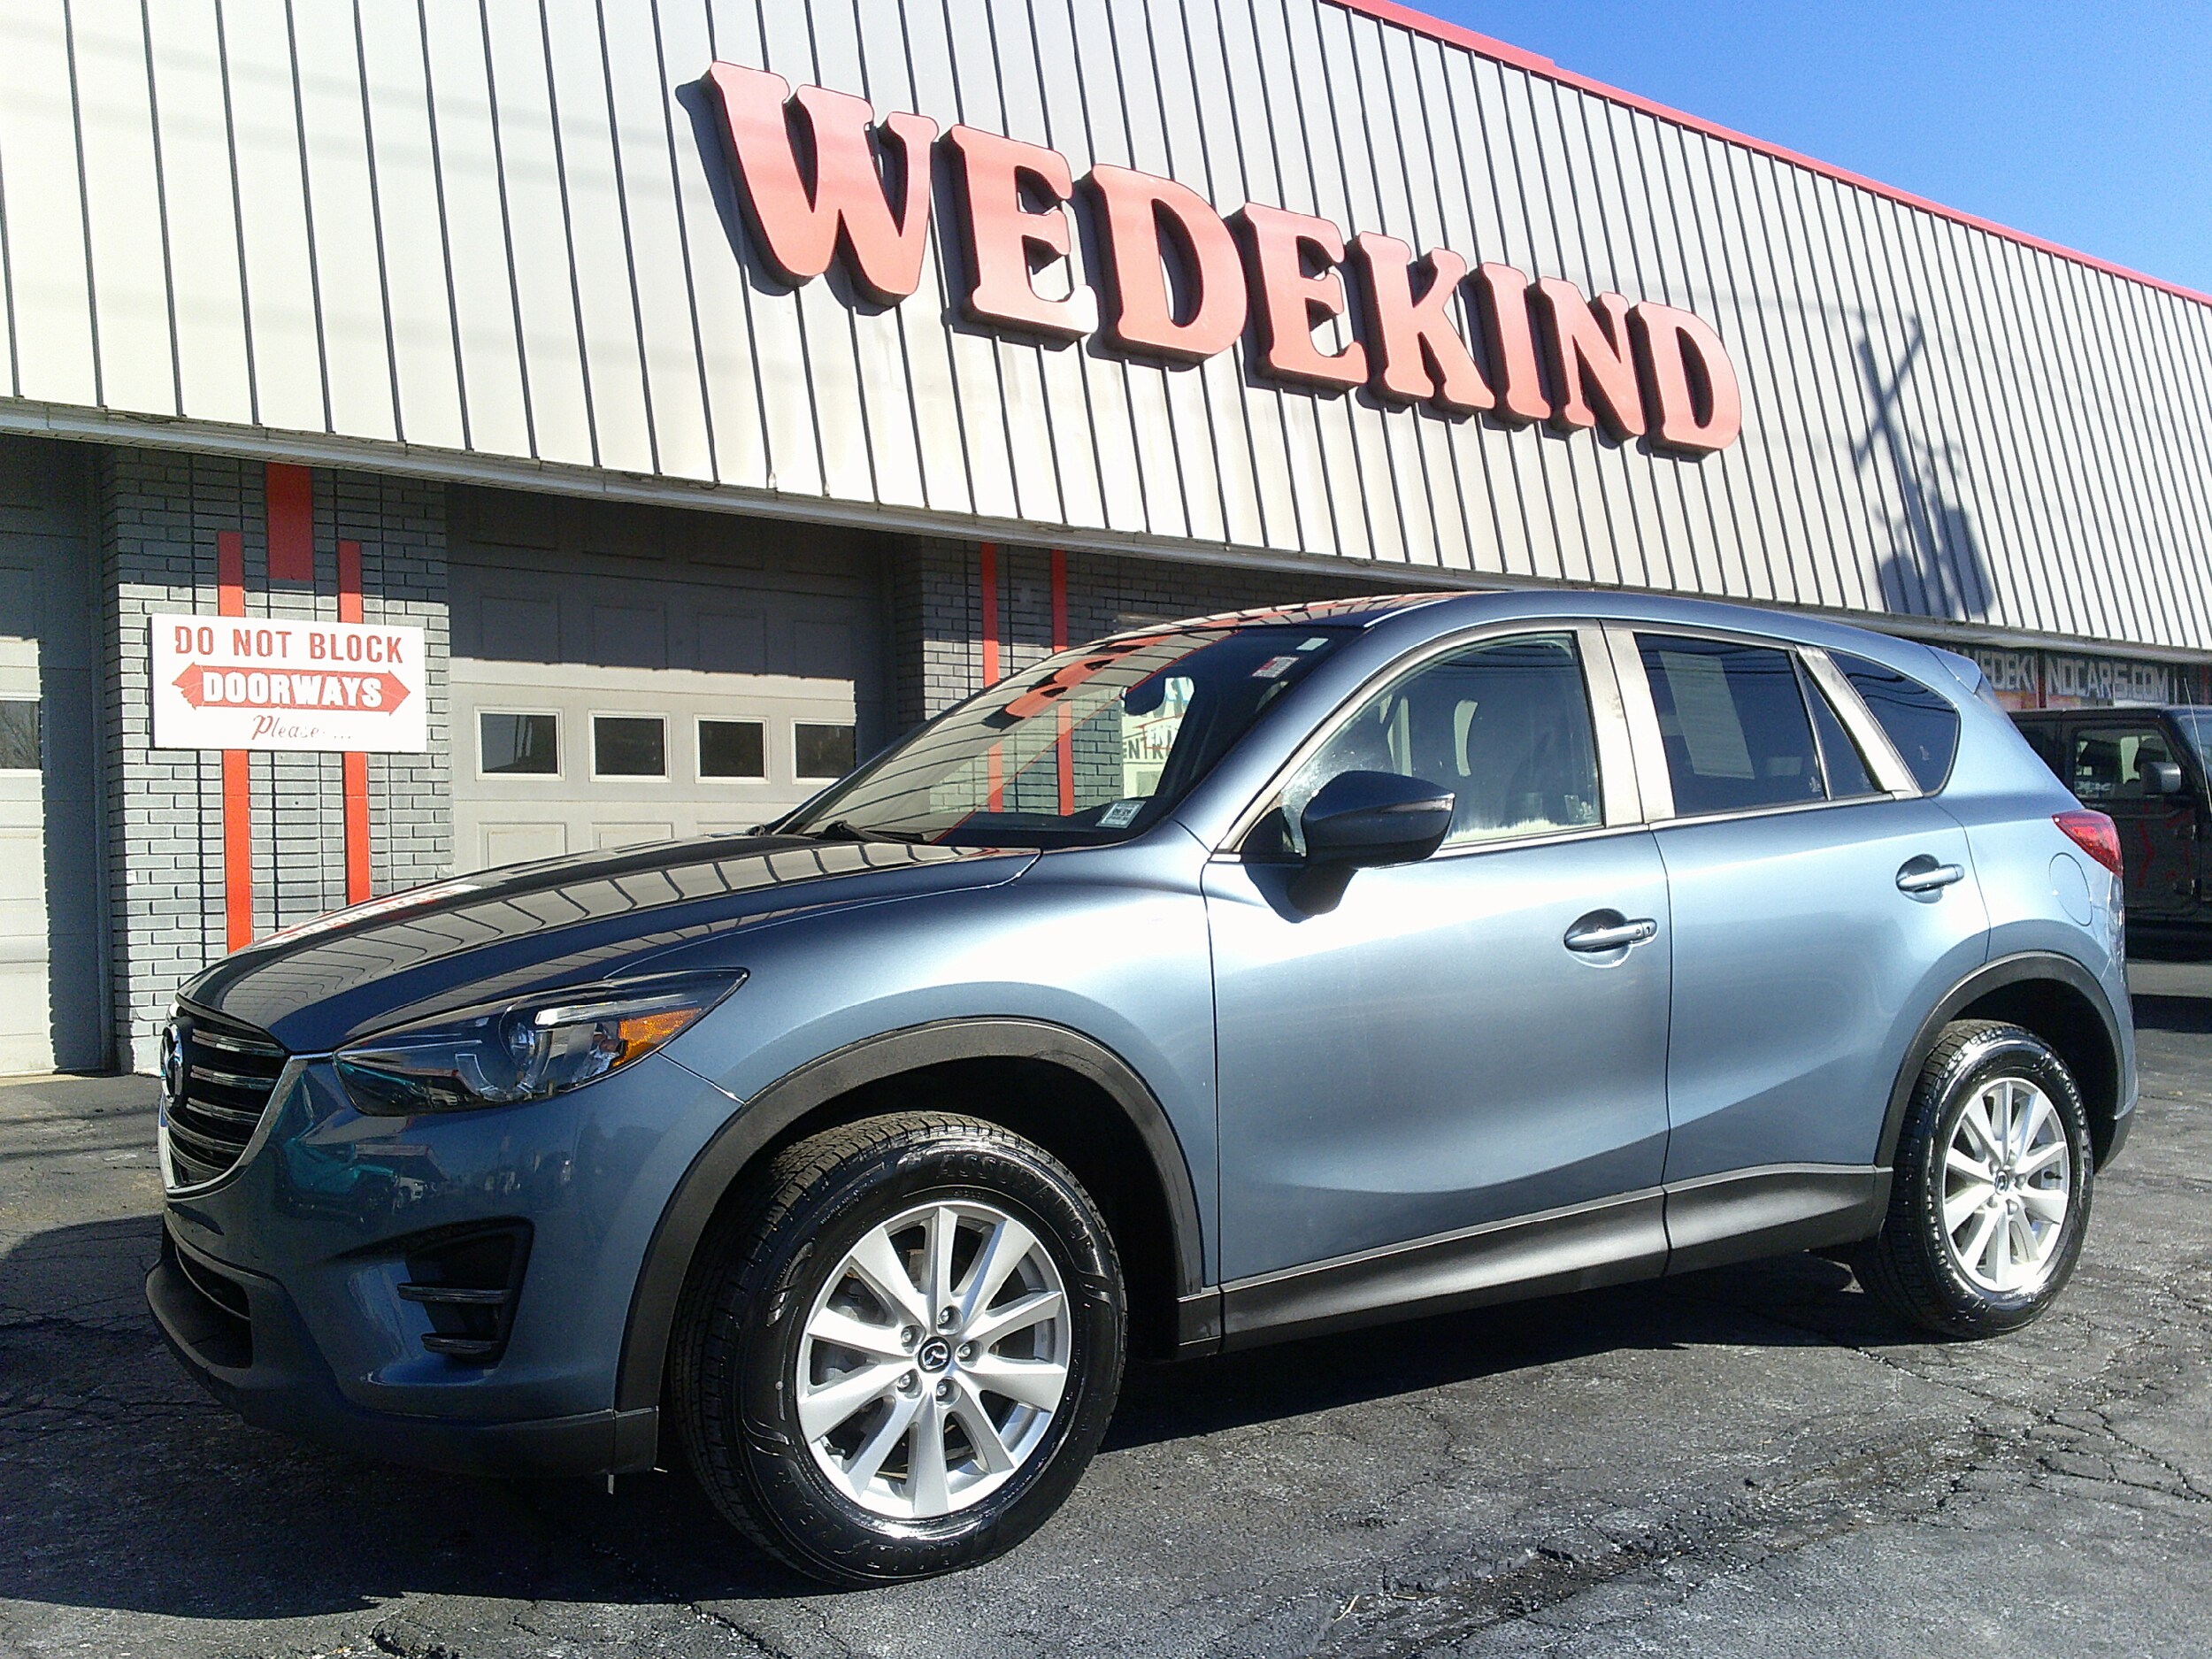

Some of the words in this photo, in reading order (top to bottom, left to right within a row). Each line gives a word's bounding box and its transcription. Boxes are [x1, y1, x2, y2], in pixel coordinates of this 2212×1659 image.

[708, 59, 1742, 454] WEDEKIND
[174, 626, 214, 655] DO
[233, 628, 292, 657] NOT
[310, 632, 403, 664] BLOCK
[202, 670, 383, 709] DOORWAYS
